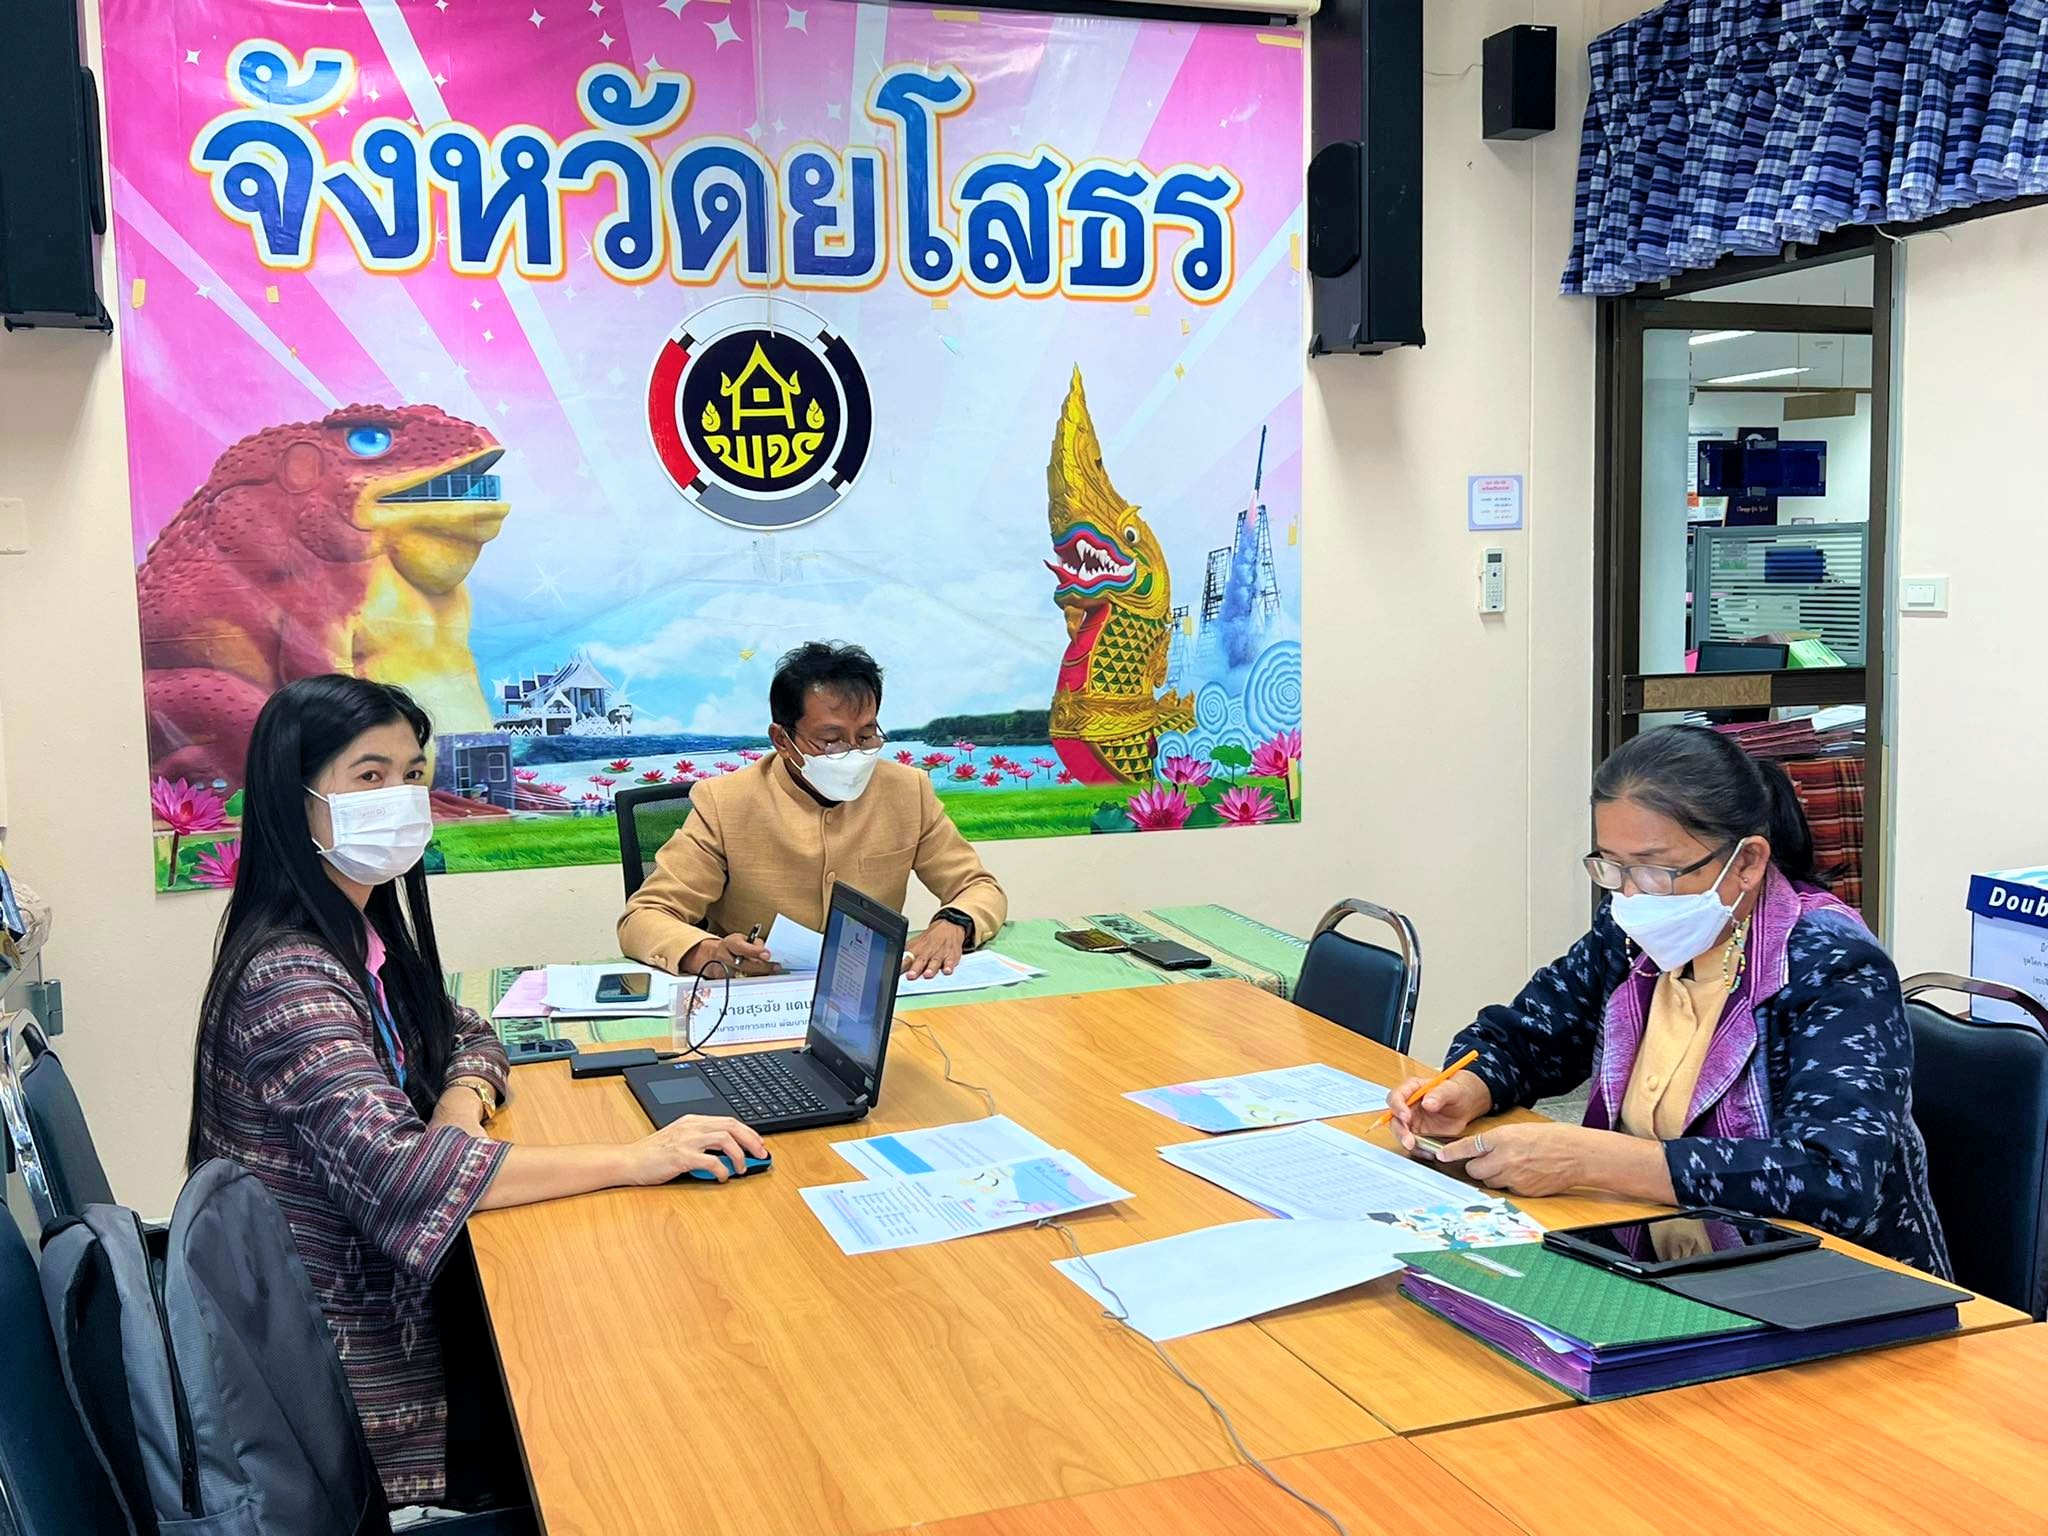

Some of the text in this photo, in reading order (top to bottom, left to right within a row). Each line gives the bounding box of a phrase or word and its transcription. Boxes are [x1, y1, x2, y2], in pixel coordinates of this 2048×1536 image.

[200, 47, 1236, 293] จังหวัดยโสธร
[1988, 886, 2048, 918] Doub
